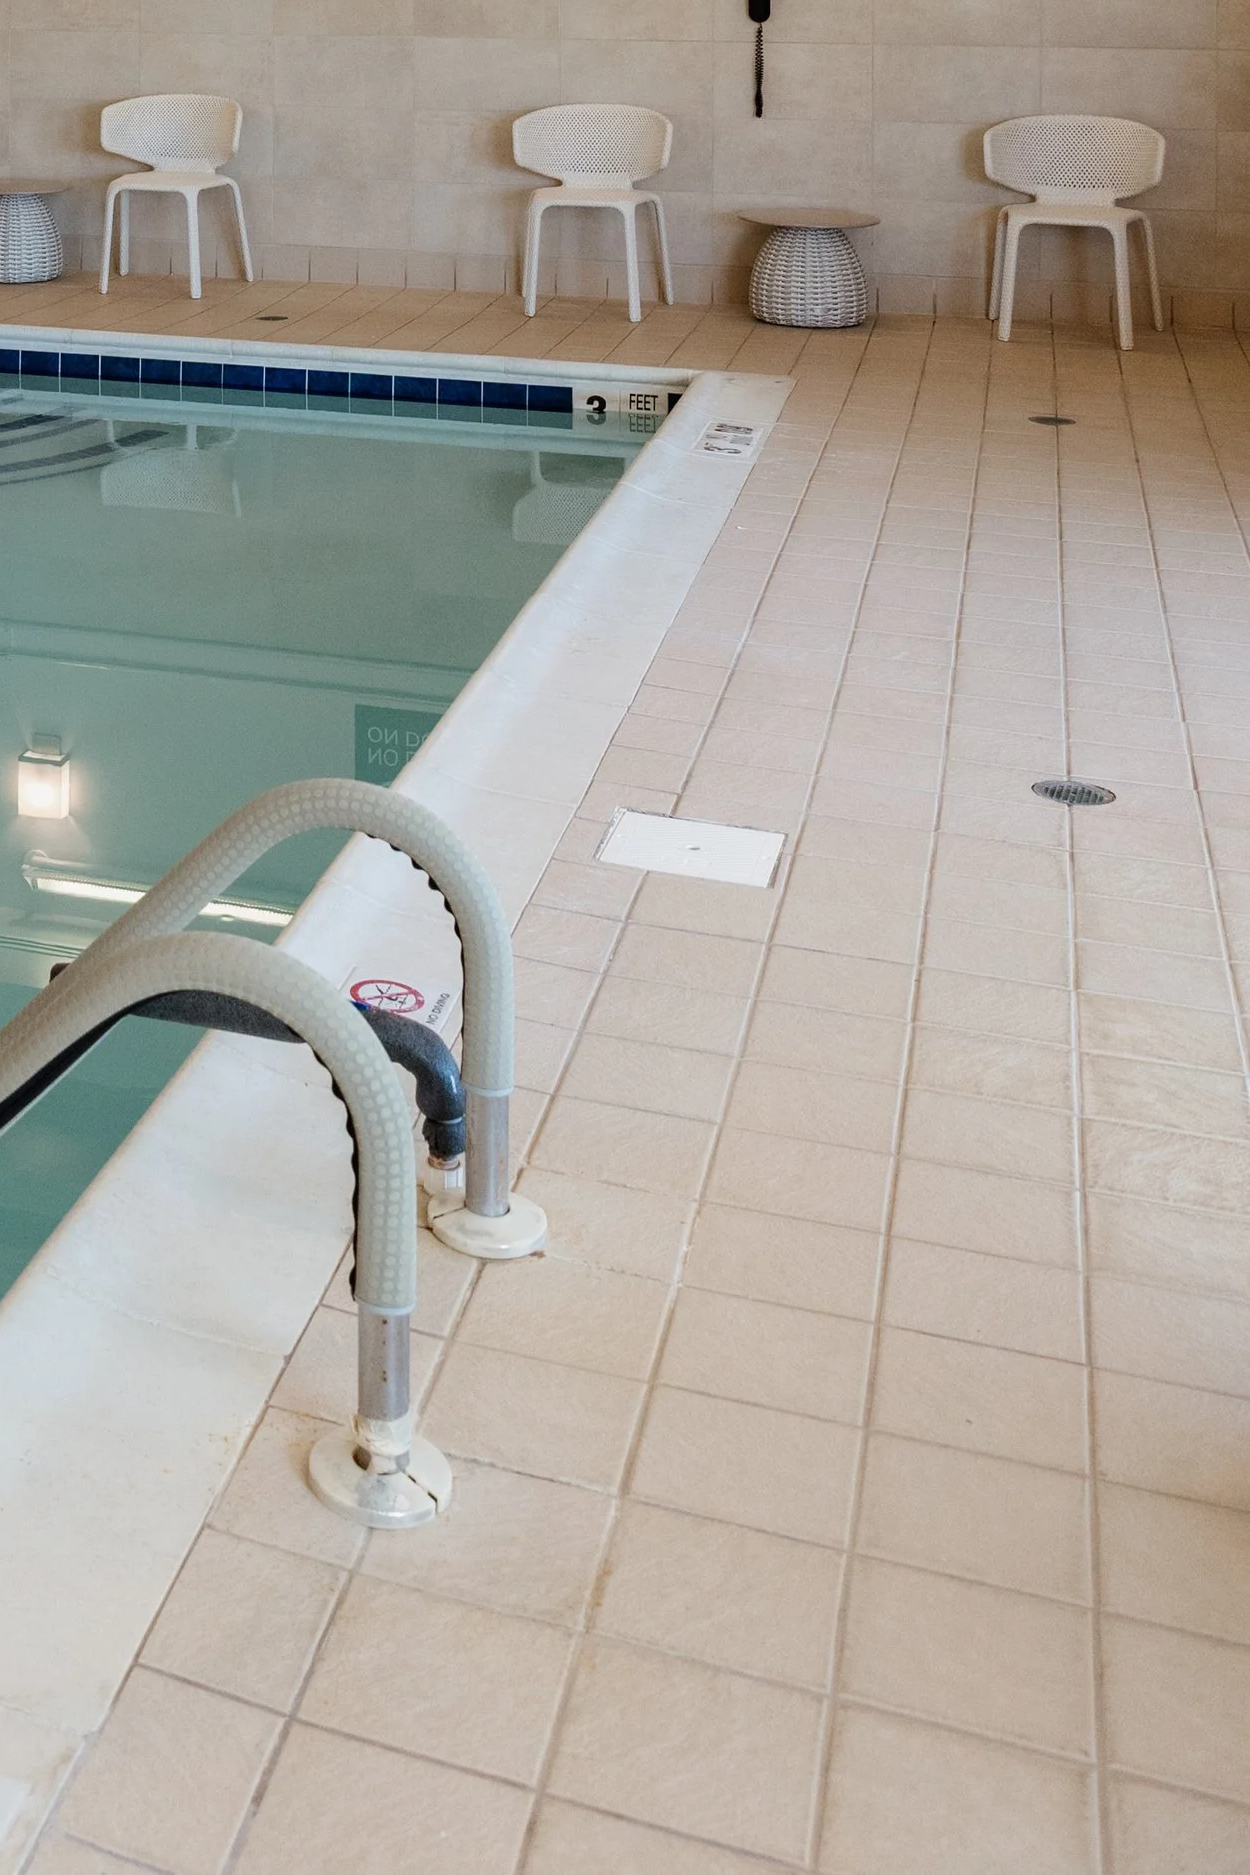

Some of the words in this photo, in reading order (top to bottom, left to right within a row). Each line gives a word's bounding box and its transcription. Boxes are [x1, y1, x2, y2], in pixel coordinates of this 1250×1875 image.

[586, 395, 606, 420] 3
[629, 393, 658, 411] FEET
[431, 992, 450, 1014] DIVING
[426, 1013, 438, 1025] NO
